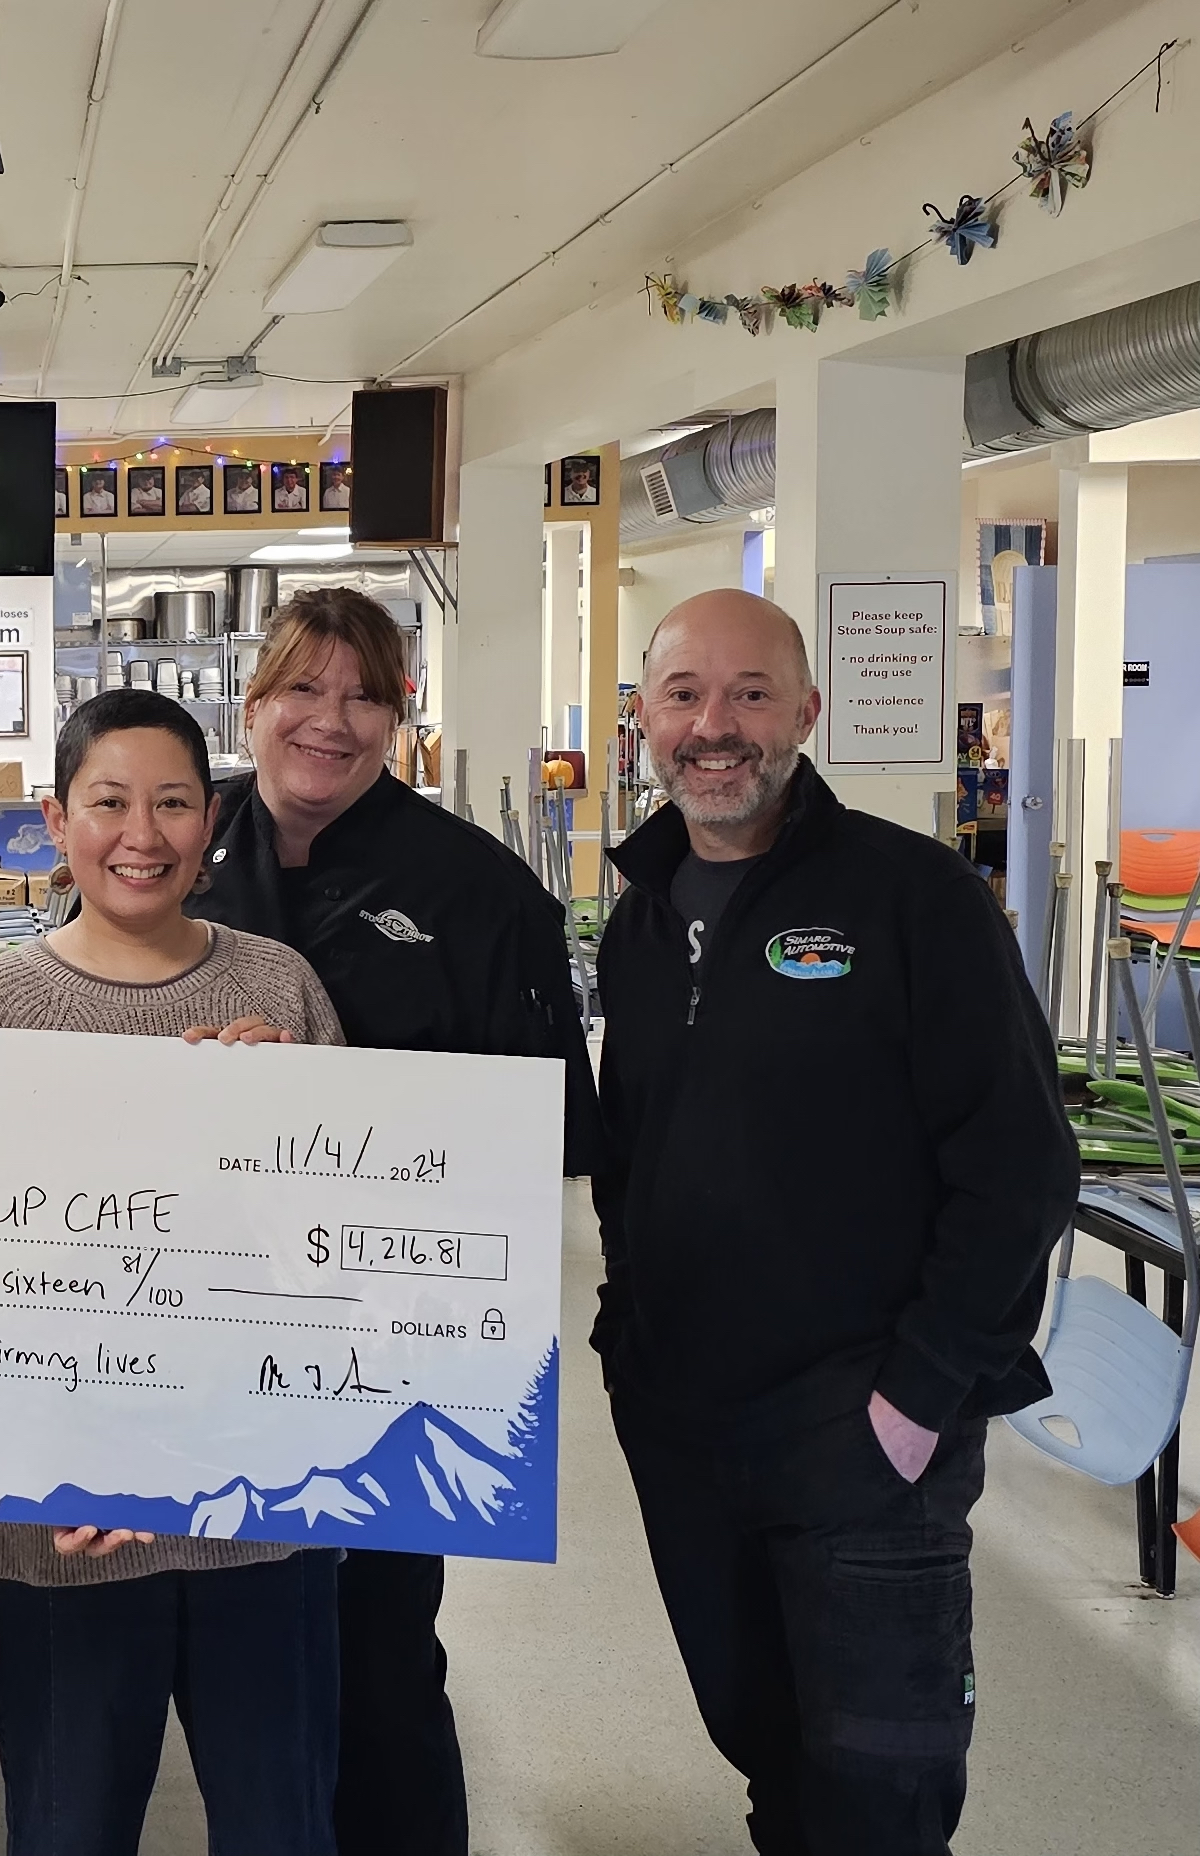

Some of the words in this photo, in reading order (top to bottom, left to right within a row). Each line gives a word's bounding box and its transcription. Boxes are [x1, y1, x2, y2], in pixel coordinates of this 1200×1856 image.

[851, 610, 891, 621] Please
[894, 610, 923, 621] keep
[837, 625, 872, 635] Stone
[875, 624, 906, 636] Soup
[908, 624, 938, 634] safe:
[850, 655, 864, 664] no
[867, 653, 917, 664] drinking
[921, 654, 934, 662] or
[860, 668, 888, 679] drug
[892, 668, 912, 677] use
[857, 698, 872, 706] no
[875, 696, 924, 706] violence
[853, 724, 890, 734] Thank
[892, 723, 919, 736] you!
[957, 752, 967, 760] AY
[784, 935, 831, 945] SIMARD
[784, 943, 856, 955] AUTOMOTIVE
[219, 1157, 262, 1173] DATE
[64, 1188, 180, 1234] CAFE
[307, 1224, 330, 1265] $
[346, 1230, 462, 1269] 4,216.81
[0, 1260, 107, 1300] sixteen
[391, 1321, 467, 1339] DOLLARS
[96, 1345, 157, 1376] lives
